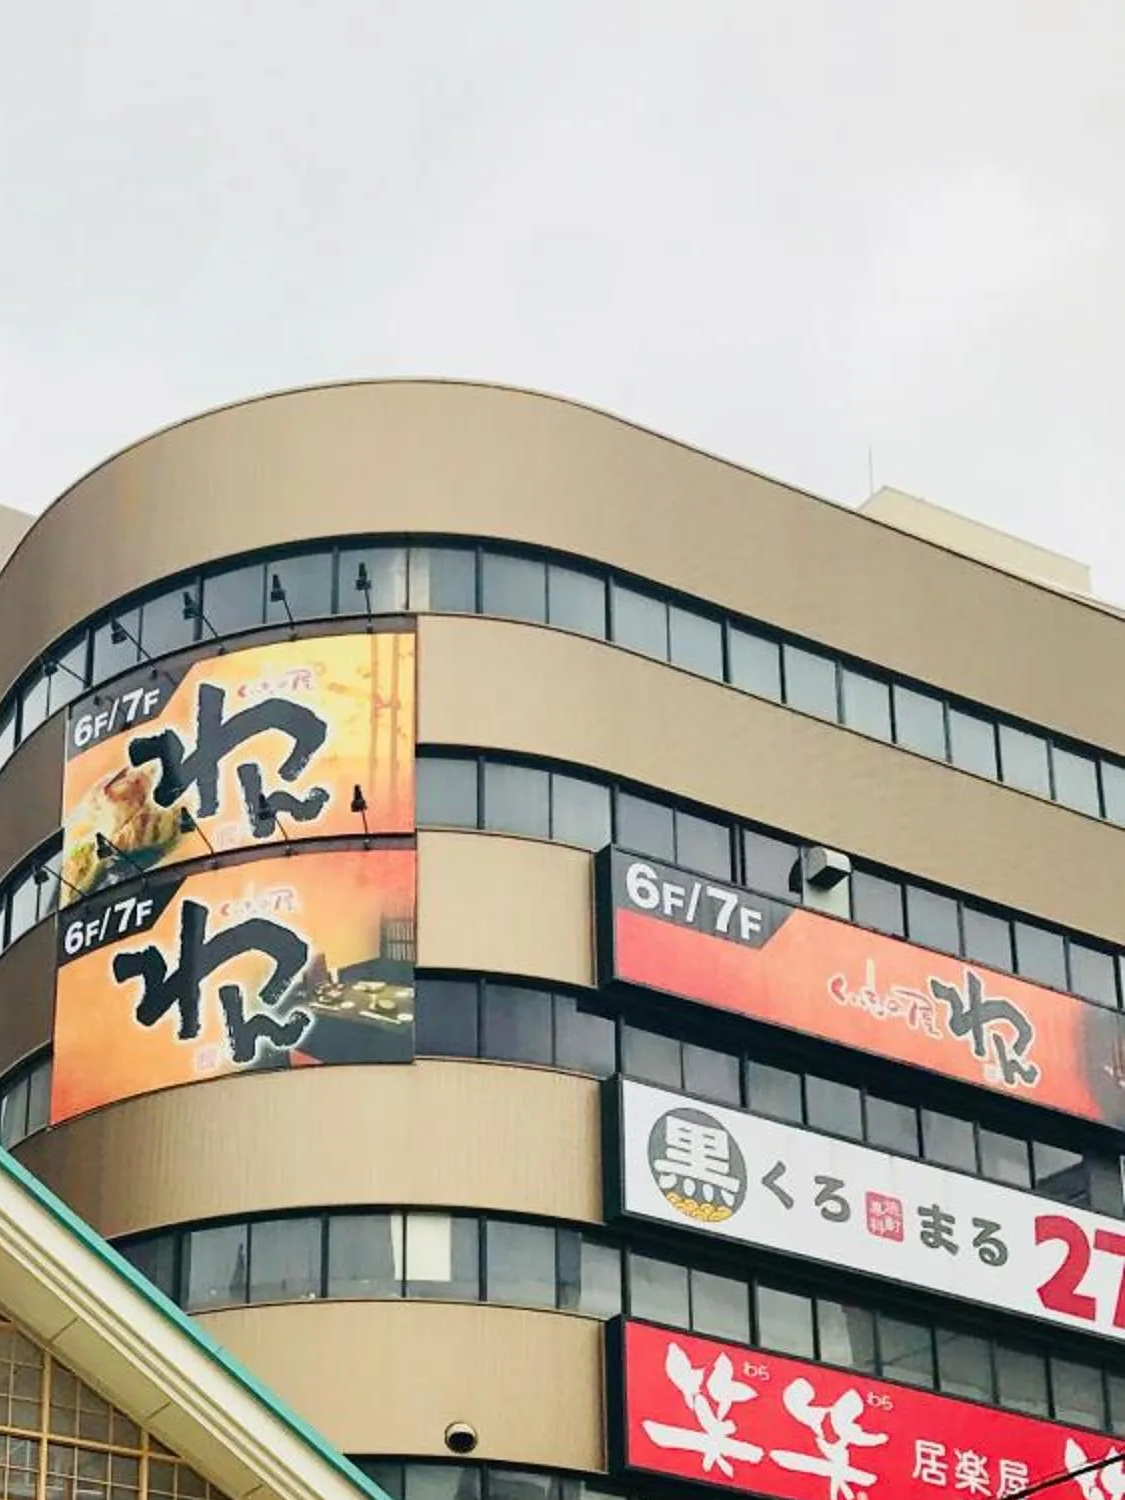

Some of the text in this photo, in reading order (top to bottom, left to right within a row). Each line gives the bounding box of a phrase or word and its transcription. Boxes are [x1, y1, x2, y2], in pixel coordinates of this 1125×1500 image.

[75, 688, 160, 748] 6F/7F
[128, 683, 329, 838] わん
[64, 899, 154, 955] 6F/7F
[626, 863, 763, 942] 6F/7F
[113, 901, 310, 1063] わん
[930, 971, 1038, 1084] わん
[762, 1161, 851, 1221] くろ
[917, 1204, 1008, 1266] まる
